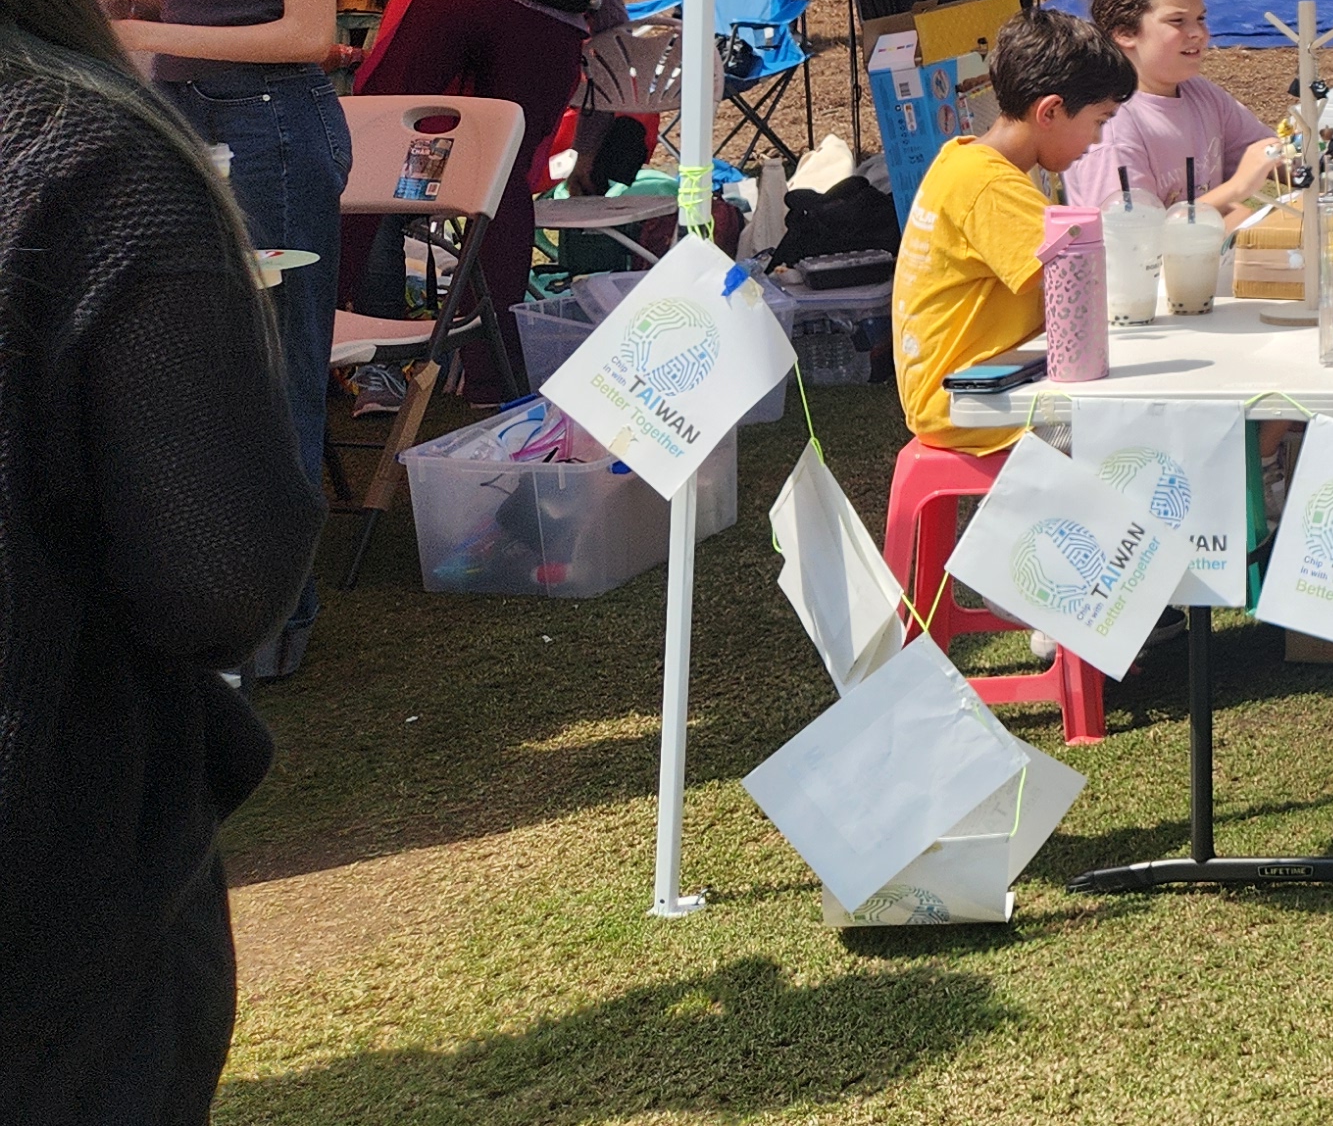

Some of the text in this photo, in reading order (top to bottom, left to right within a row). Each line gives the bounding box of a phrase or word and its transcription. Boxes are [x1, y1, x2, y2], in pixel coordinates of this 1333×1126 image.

[603, 363, 627, 386] in with
[611, 355, 628, 373] Chip
[590, 373, 686, 459] Better Together
[629, 374, 701, 445] TAIWAN
[1090, 522, 1146, 600] TAIWAN
[1187, 558, 1227, 570] ether
[1304, 555, 1323, 568] Chip
[1300, 566, 1328, 580] in with
[1096, 536, 1161, 637] Better Together
[1077, 603, 1091, 621] Chip
[1087, 602, 1104, 628] in with
